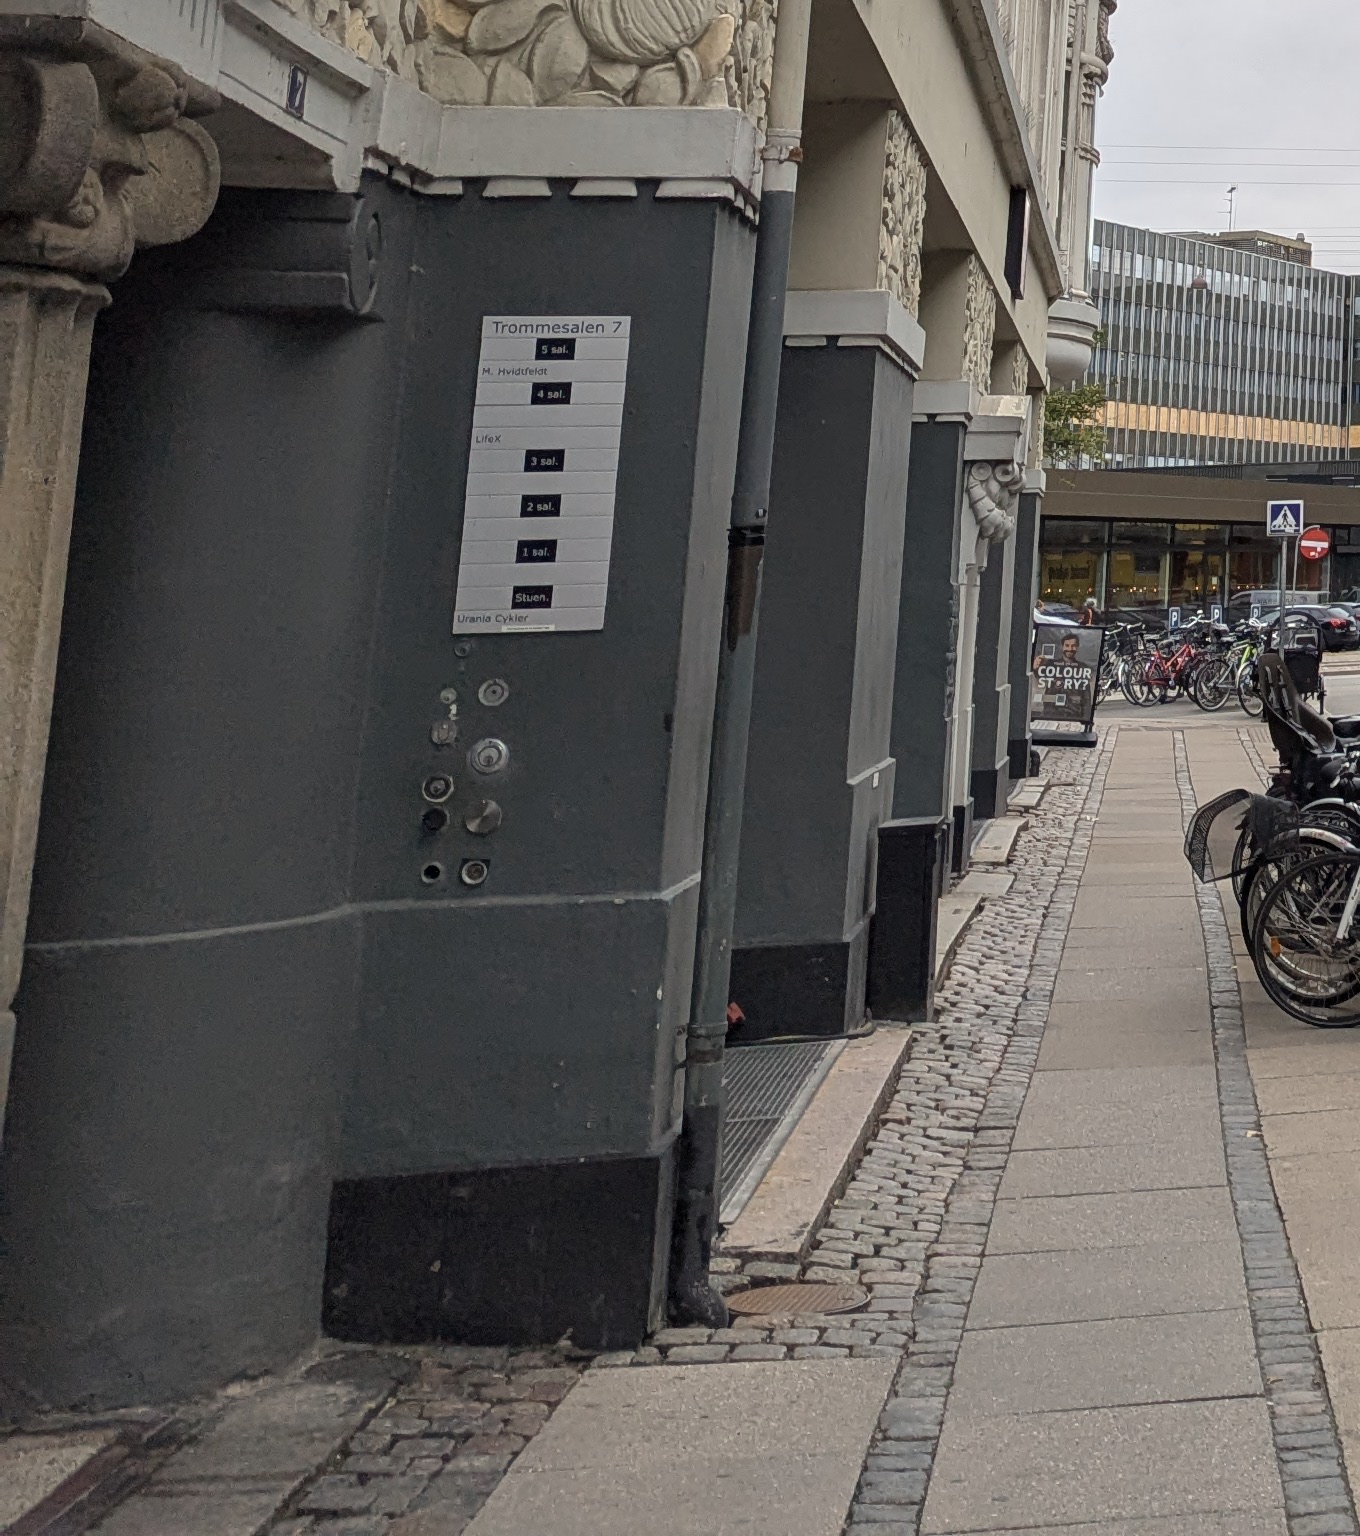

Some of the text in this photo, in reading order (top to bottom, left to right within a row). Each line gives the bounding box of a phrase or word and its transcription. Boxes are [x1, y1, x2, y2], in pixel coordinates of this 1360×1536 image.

[492, 320, 622, 334] Trommesalen 7
[541, 345, 569, 355] 5 sal.
[482, 367, 494, 376] M.
[537, 389, 565, 400] 4 sal.
[475, 434, 502, 444] LifeX
[530, 456, 559, 466] 3 sal.
[527, 502, 555, 512] 2 sal.
[522, 547, 550, 557] 1 sal.
[515, 592, 549, 603] Stuen.
[457, 613, 529, 624] Urania Cykler
[1038, 666, 1091, 679] COLOUR
